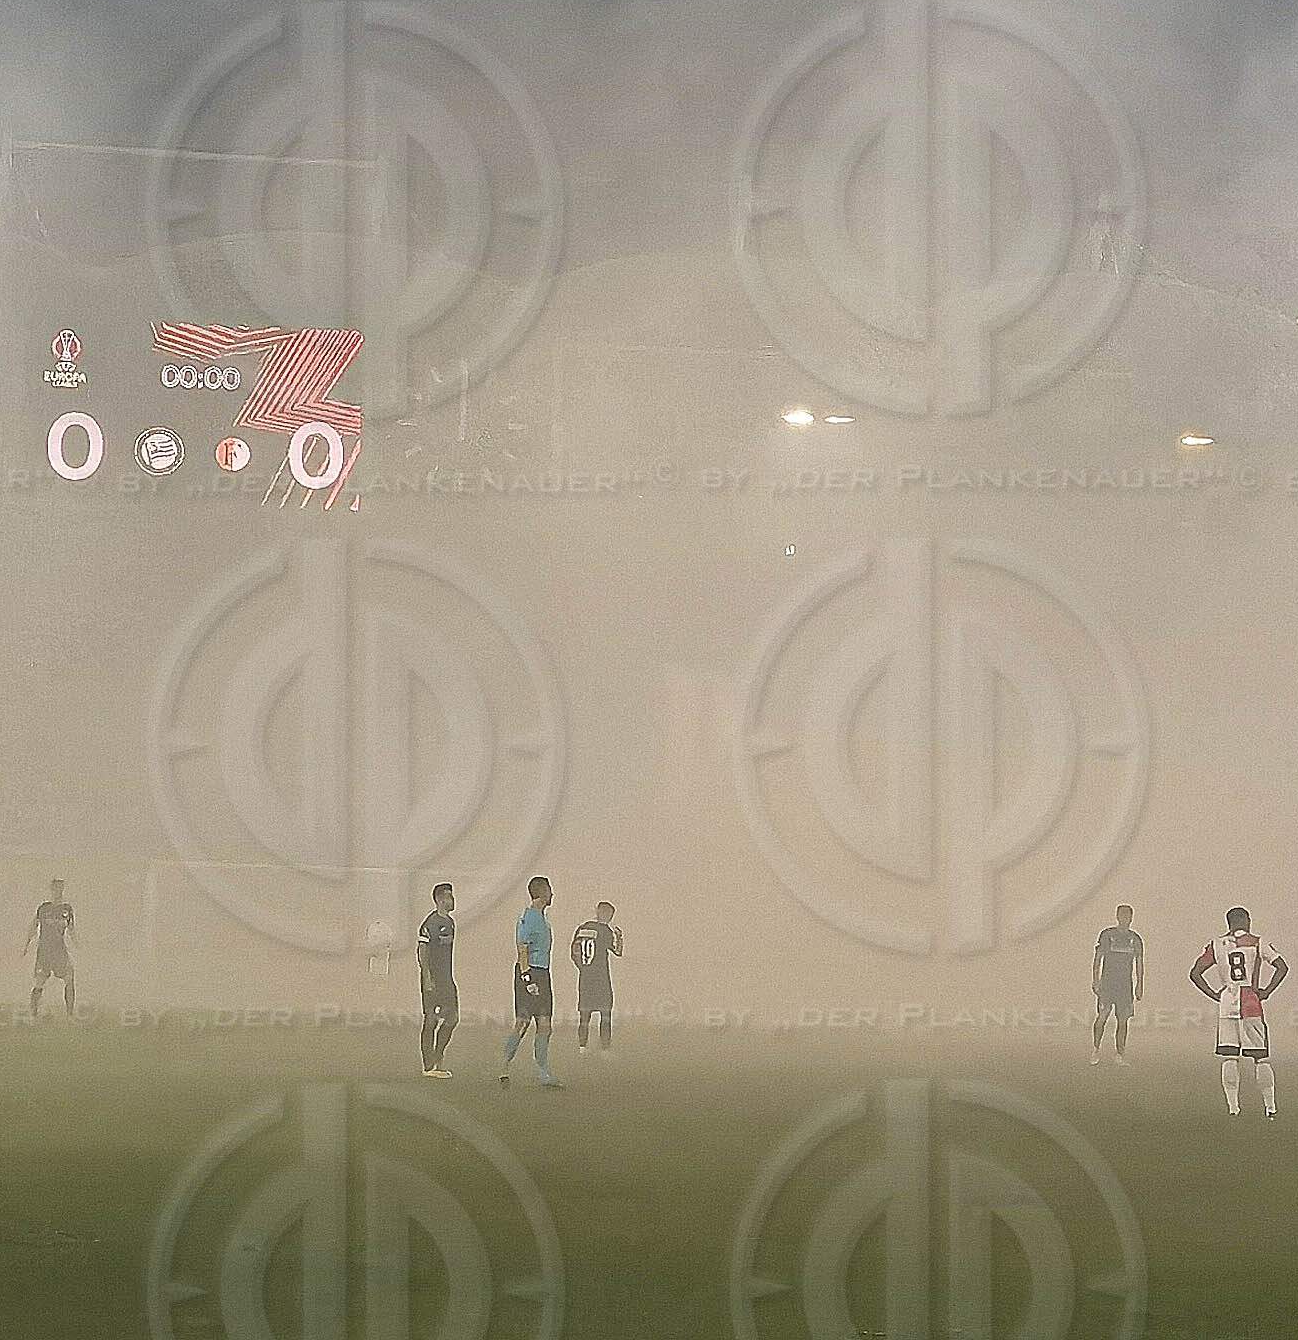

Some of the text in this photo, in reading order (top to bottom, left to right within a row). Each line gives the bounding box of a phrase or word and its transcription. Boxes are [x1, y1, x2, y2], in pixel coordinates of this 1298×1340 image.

[161, 363, 241, 391] 00:00
[47, 411, 104, 481] 0
[288, 420, 345, 490] 0
[1228, 951, 1247, 981] 8
